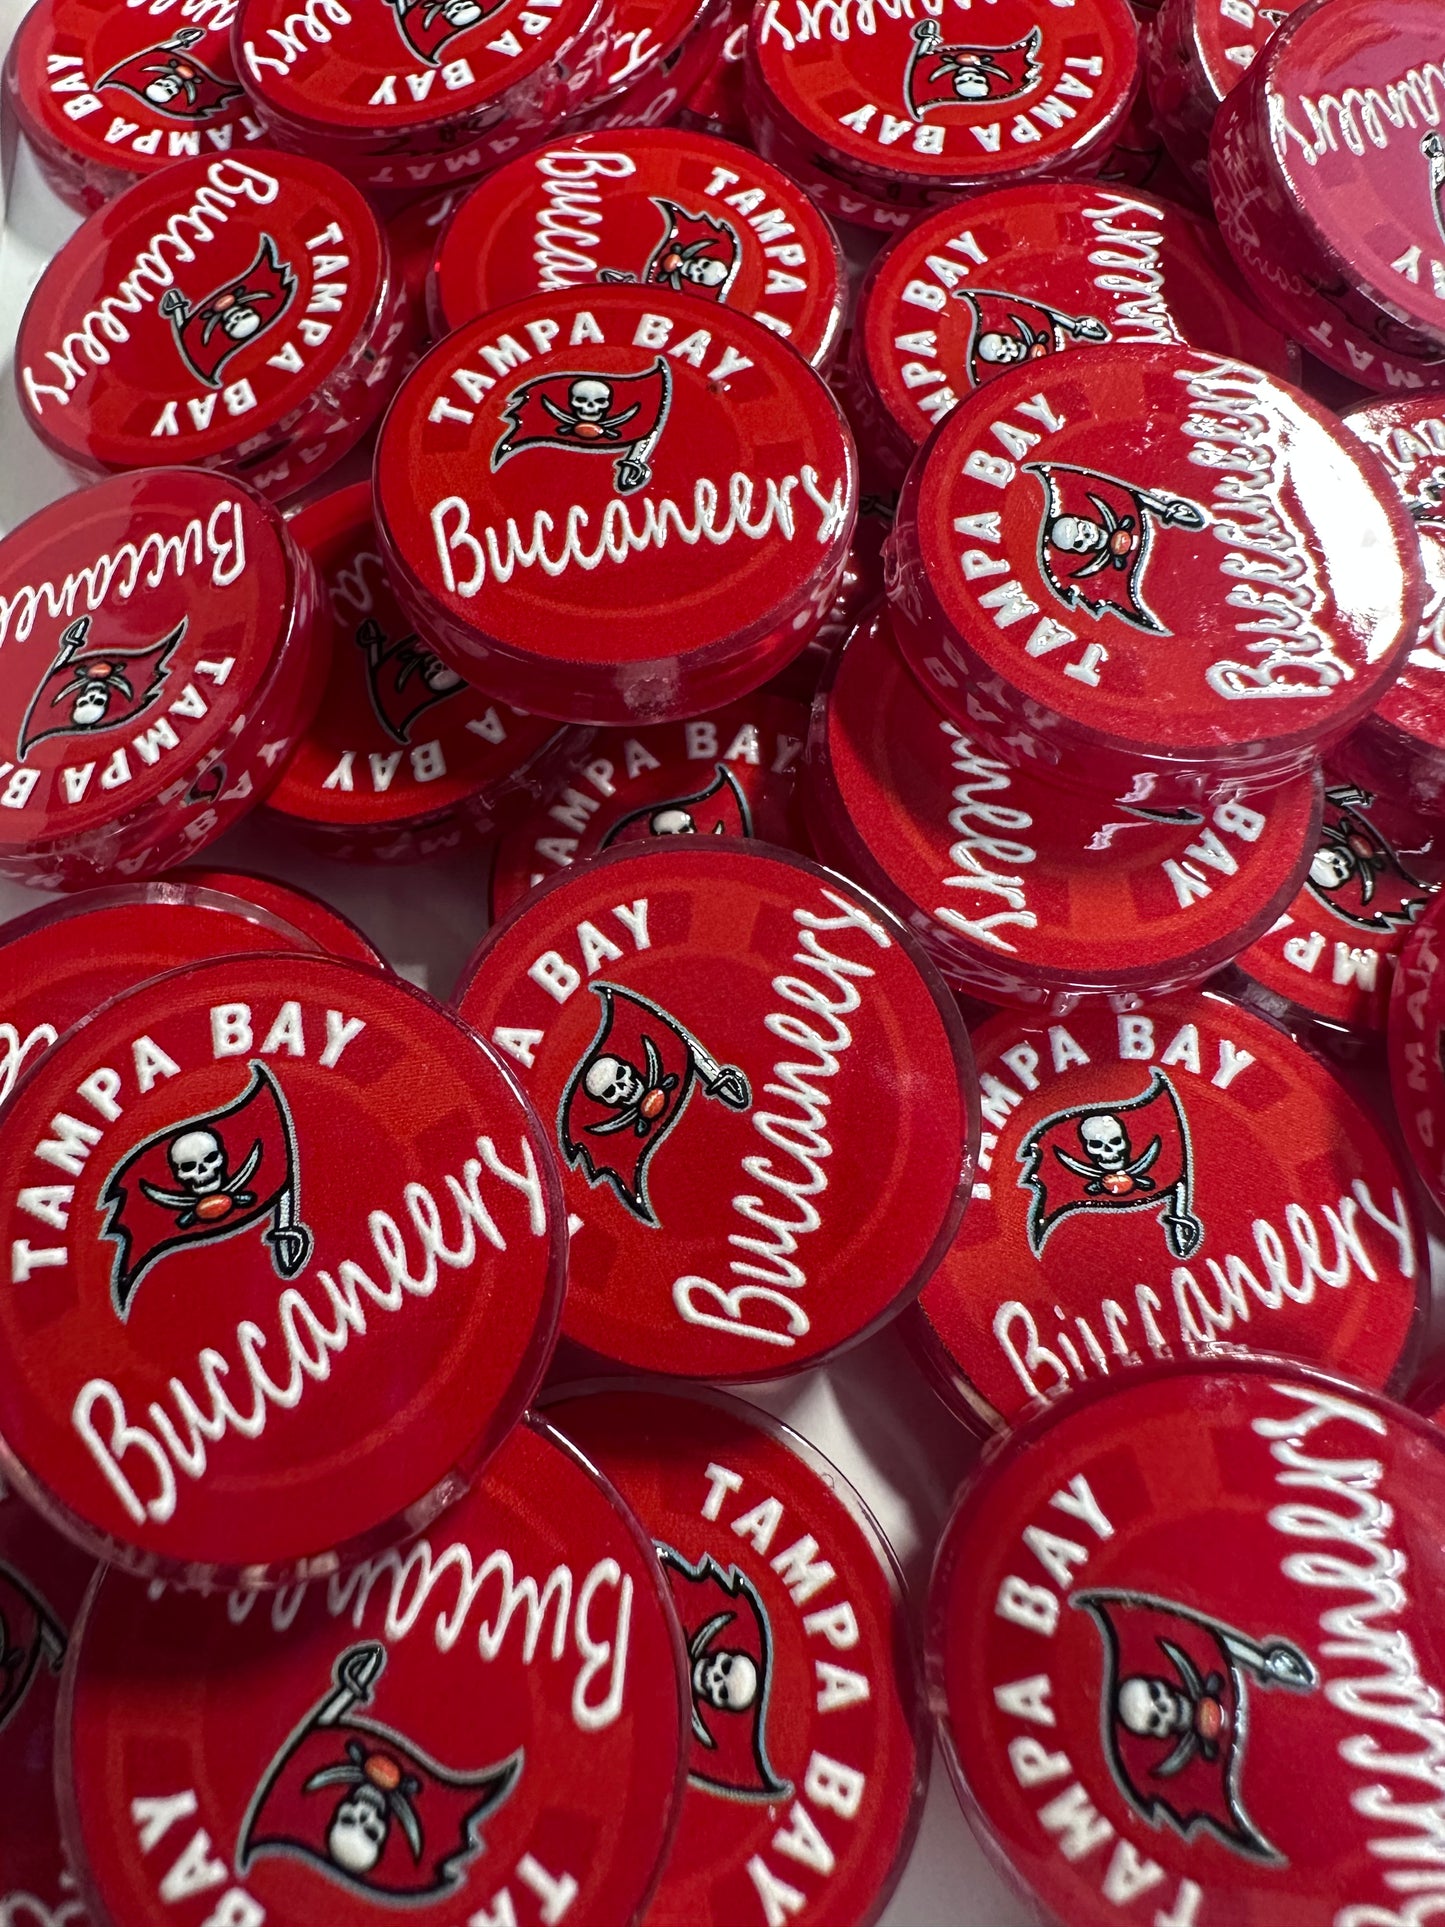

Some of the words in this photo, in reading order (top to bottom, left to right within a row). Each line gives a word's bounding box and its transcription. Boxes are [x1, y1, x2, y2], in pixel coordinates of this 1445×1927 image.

[46, 54, 103, 121] BAY
[104, 116, 268, 157] TAMPA
[368, 58, 476, 105] BAY
[838, 104, 946, 155] BAY
[969, 56, 1103, 152] TAMPA
[22, 158, 280, 415] Buccaneers
[703, 167, 807, 295] TAMPA
[902, 230, 989, 312] BAY
[267, 222, 349, 374] TAMPA
[151, 378, 258, 437] BAY
[428, 312, 605, 424] TAMPA
[632, 314, 754, 381] BAY
[894, 331, 958, 425] MPA
[961, 393, 1067, 489] BAY
[429, 465, 848, 598] Buccaneers
[954, 512, 1109, 688] TAMPA
[63, 657, 236, 804] TAMPA
[323, 740, 446, 793] BAY
[531, 738, 661, 889] AMPA
[1162, 800, 1266, 909] BAY
[528, 899, 650, 1004] BAY
[1117, 1015, 1256, 1090] BAY
[12, 1035, 181, 1284] TAMPA
[210, 1001, 367, 1067] BAY
[672, 887, 892, 1347] Buccaneers
[72, 1135, 548, 1526] Buccaneers
[701, 1462, 870, 1713] TAMPA
[994, 1473, 1115, 1636] BAY
[746, 1750, 866, 1927] BAY
